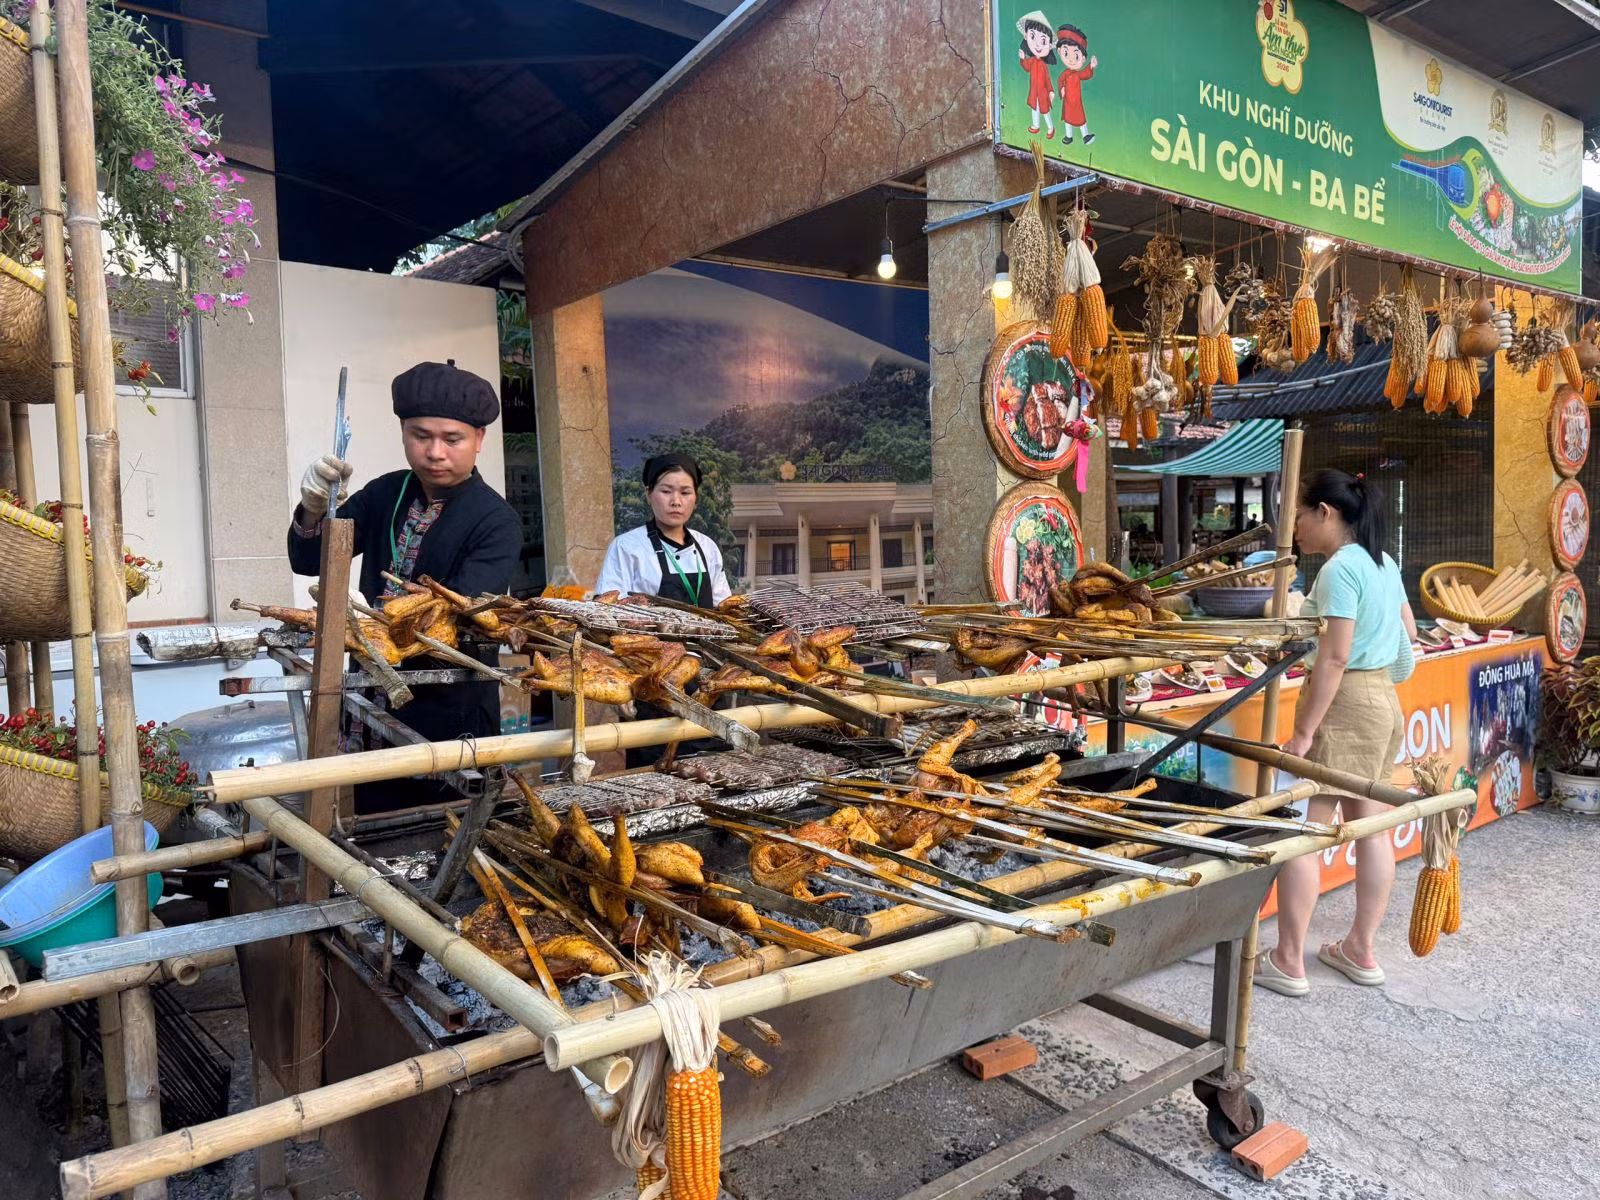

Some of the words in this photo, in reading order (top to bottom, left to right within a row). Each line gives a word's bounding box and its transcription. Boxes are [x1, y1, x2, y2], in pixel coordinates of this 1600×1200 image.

[1199, 80, 1240, 117] KHU
[1246, 98, 1291, 135] NGHĨ
[1295, 116, 1353, 157] DƯỠNG
[1150, 113, 1206, 173] SÀI
[1216, 136, 1283, 196] GÒN
[1310, 169, 1347, 215] BA
[1354, 177, 1386, 225] BỂ
[1478, 664, 1503, 689] ĐỘNG
[1521, 659, 1535, 678] MẠ
